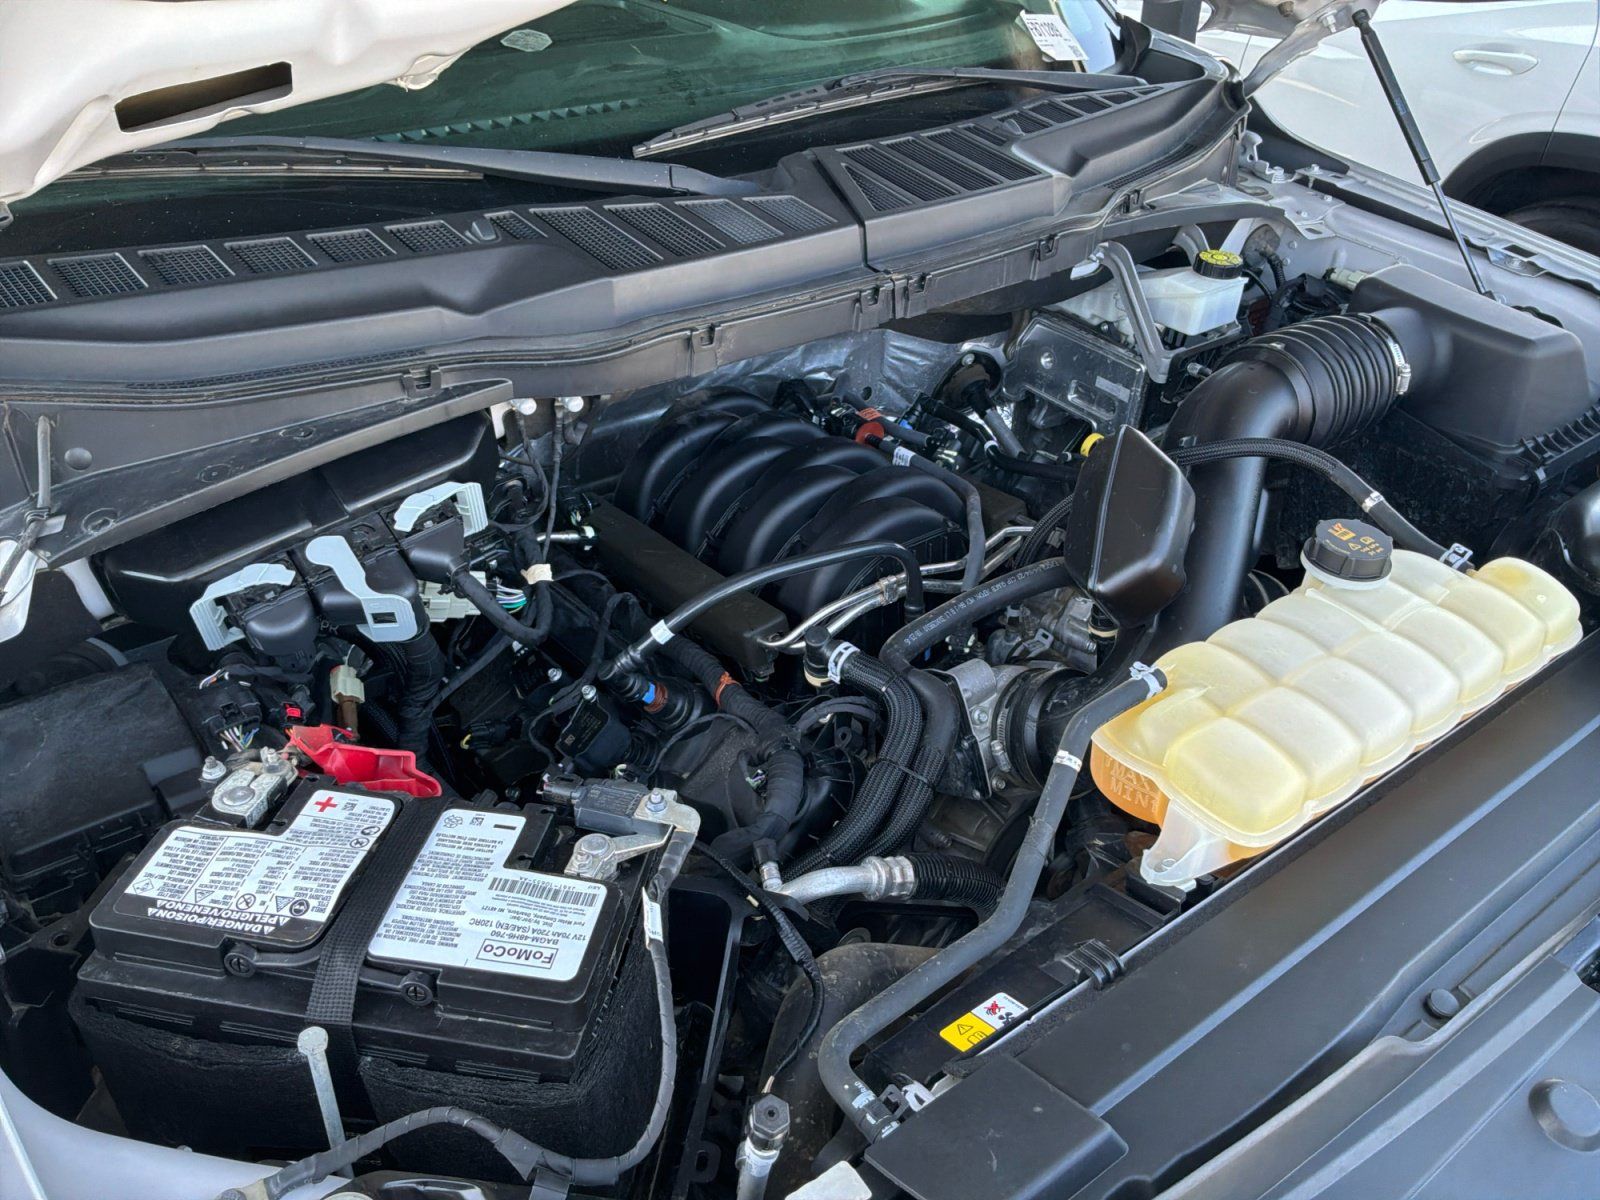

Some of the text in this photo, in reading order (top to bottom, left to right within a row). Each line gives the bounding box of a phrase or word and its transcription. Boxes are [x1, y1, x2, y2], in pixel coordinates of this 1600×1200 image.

[165, 899, 280, 925] PELIGRO/VENENO
[157, 909, 261, 933] DANGER/POISON
[468, 917, 493, 927] 120RC
[494, 920, 530, 933] (SAE/EN)
[530, 927, 550, 935] 720A
[480, 943, 554, 963] FoMoCo
